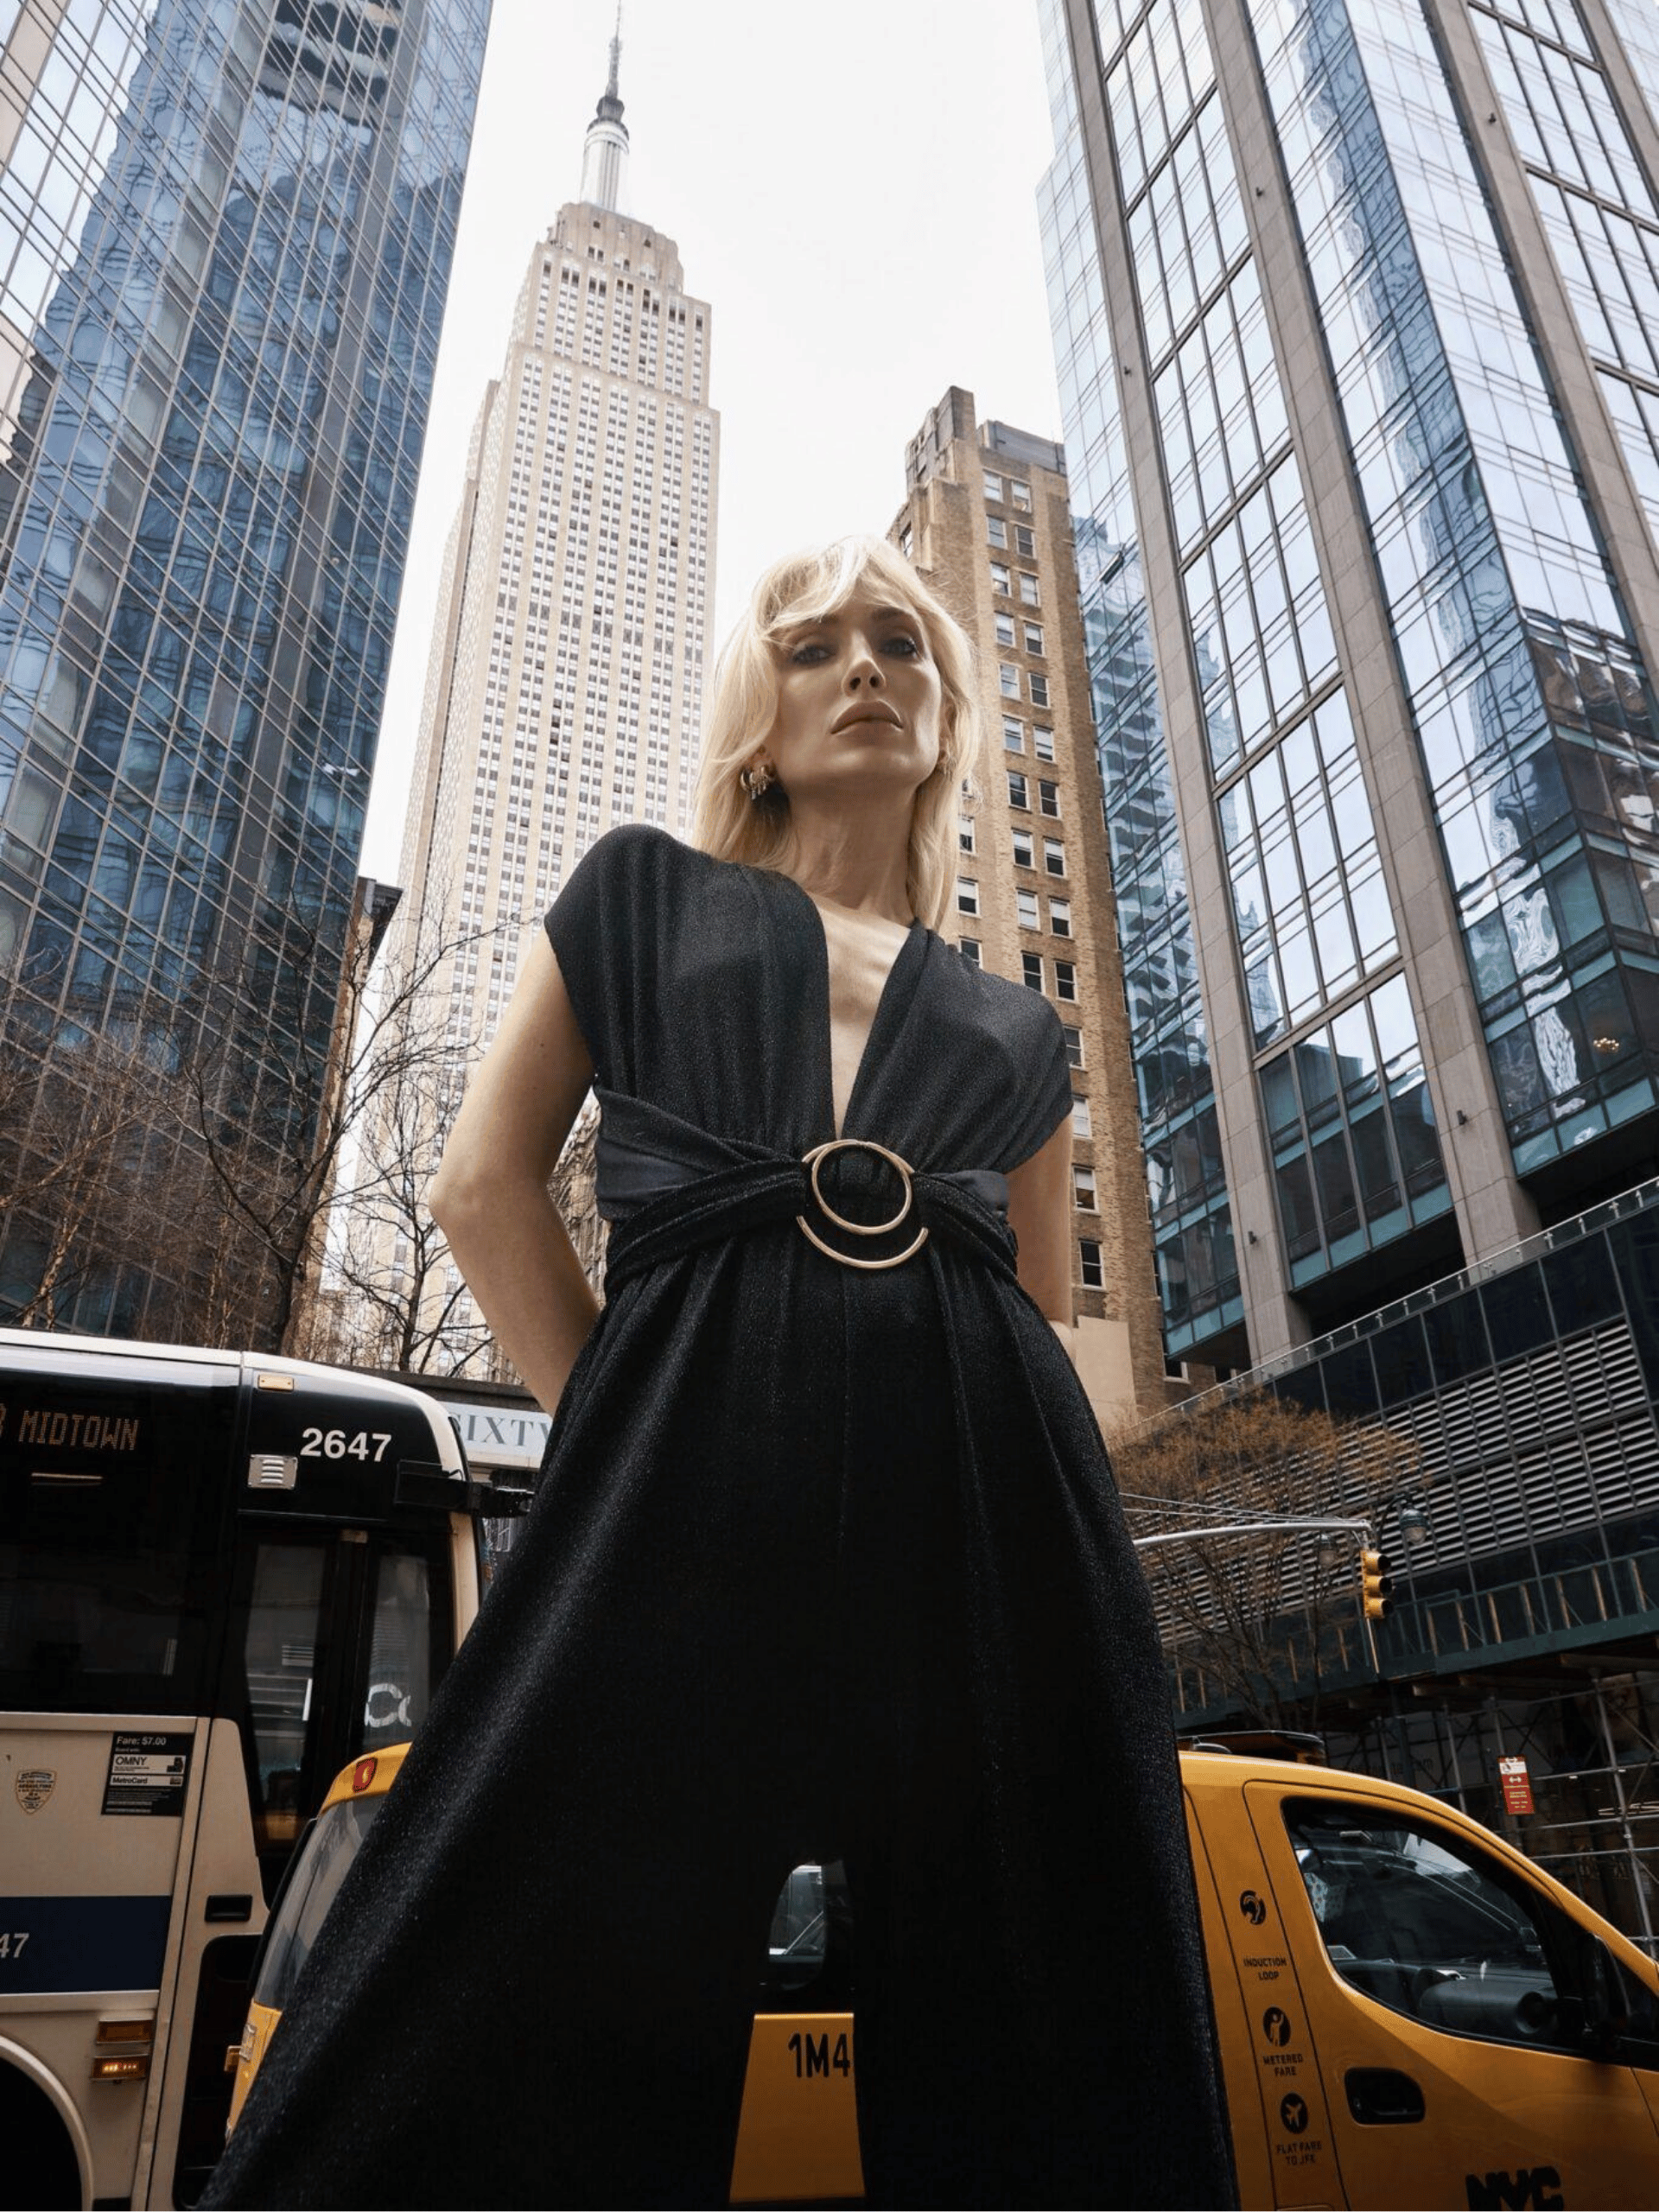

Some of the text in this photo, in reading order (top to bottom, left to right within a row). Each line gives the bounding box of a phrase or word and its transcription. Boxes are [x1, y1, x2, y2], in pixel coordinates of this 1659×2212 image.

[18, 1410, 138, 1451] MIDTOWN
[300, 1427, 392, 1462] 2647
[117, 1736, 140, 1745] Fare:
[115, 1756, 147, 1765] OMNY
[0, 1933, 29, 1958] 47
[1243, 1957, 1287, 1967] INDUCTION
[1258, 1971, 1280, 1981] LOOP
[787, 2032, 850, 2078] 1M4
[1274, 2066, 1296, 2076] FARE
[1465, 2166, 1564, 2211] NYC
